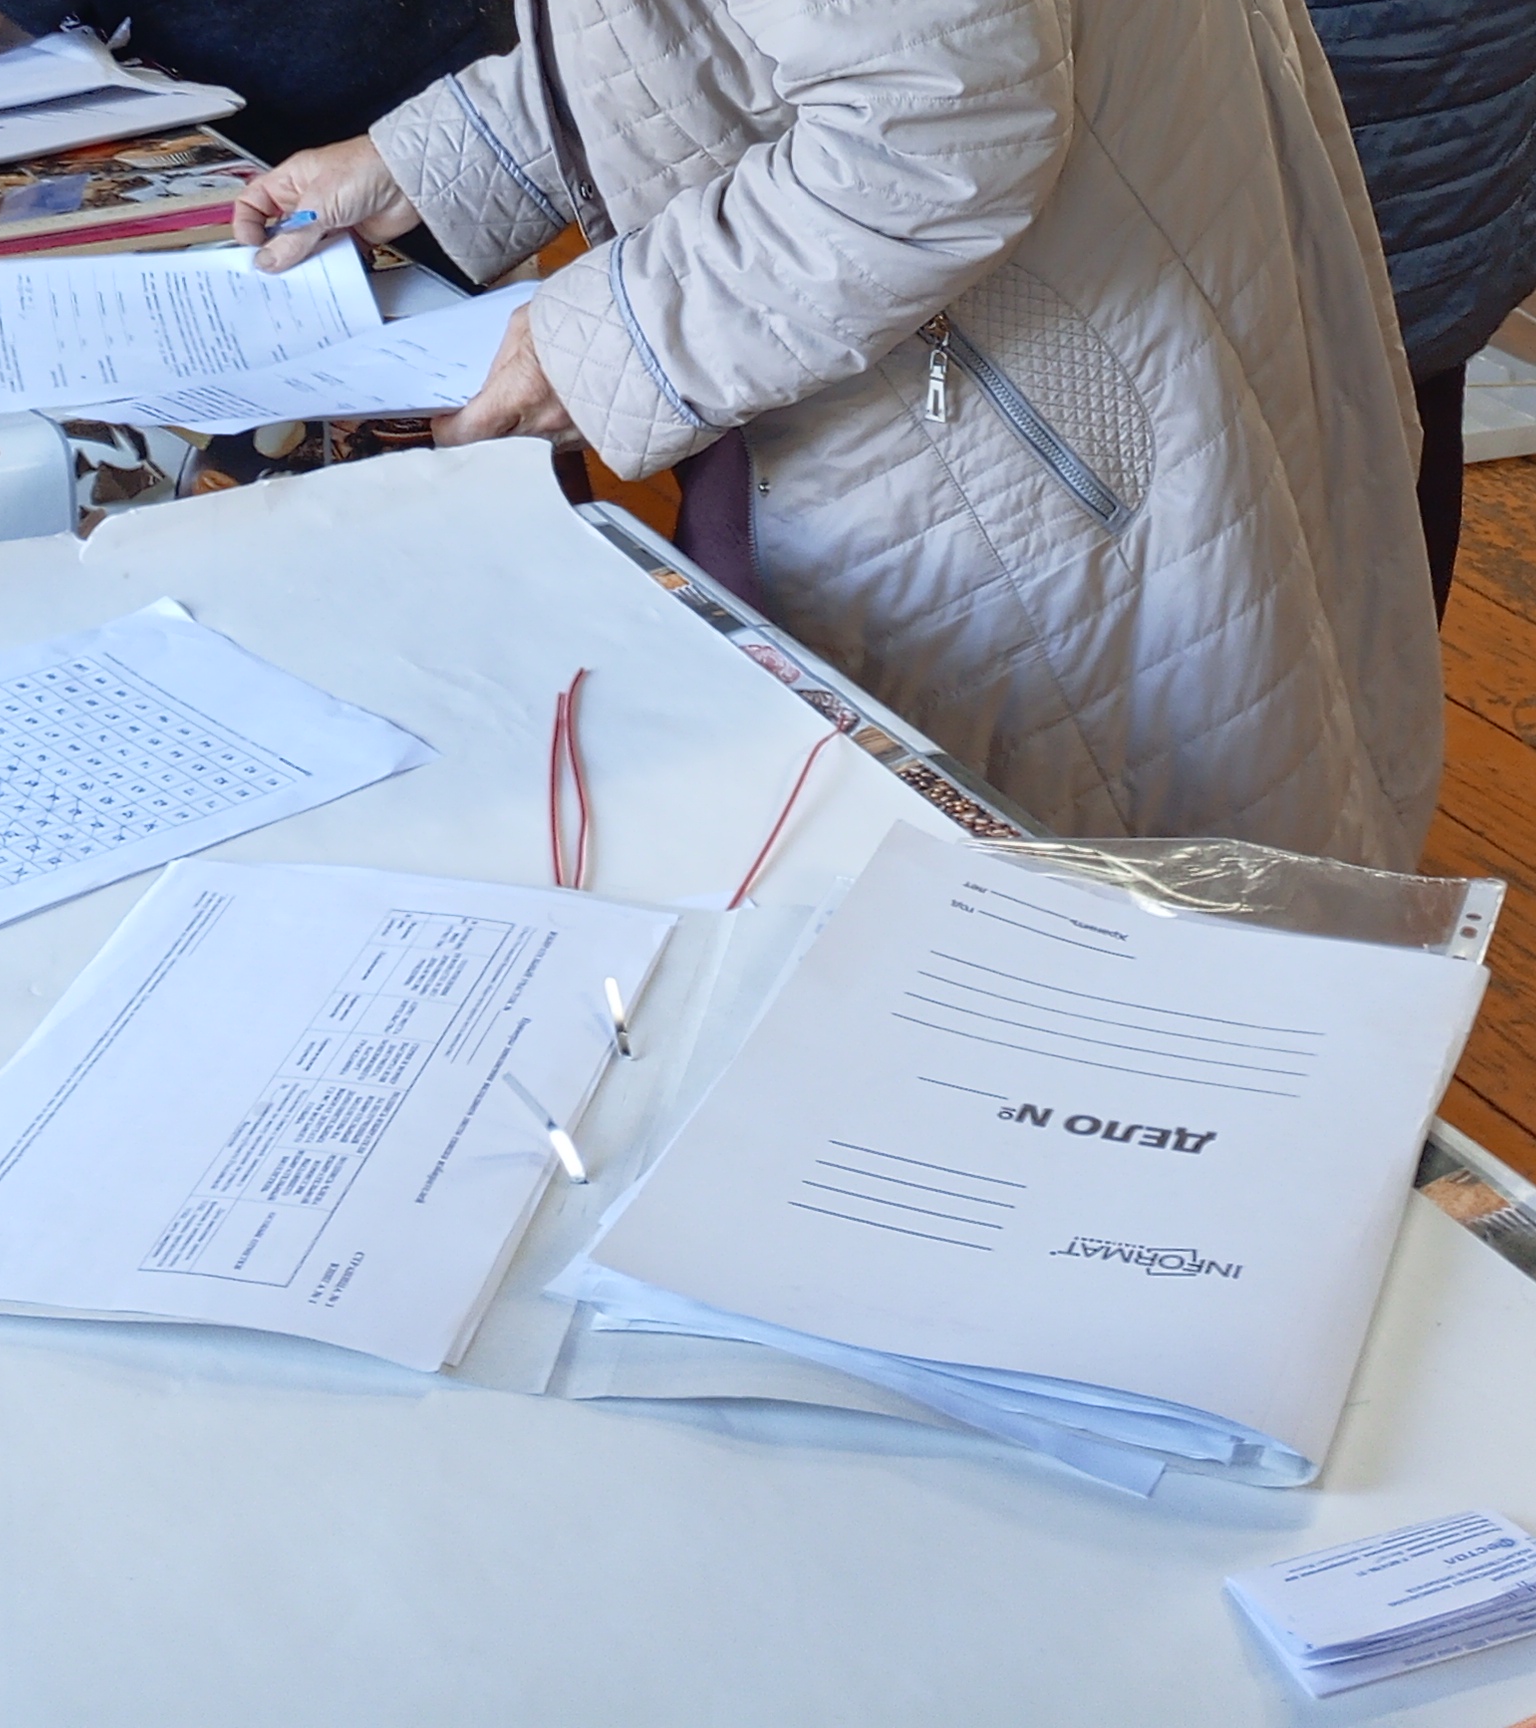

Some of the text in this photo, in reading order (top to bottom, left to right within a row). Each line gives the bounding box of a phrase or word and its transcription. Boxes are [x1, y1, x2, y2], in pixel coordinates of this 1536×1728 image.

[997, 1102, 1218, 1155] ДЕЛО №
[1056, 1240, 1244, 1280] INFORMAT
